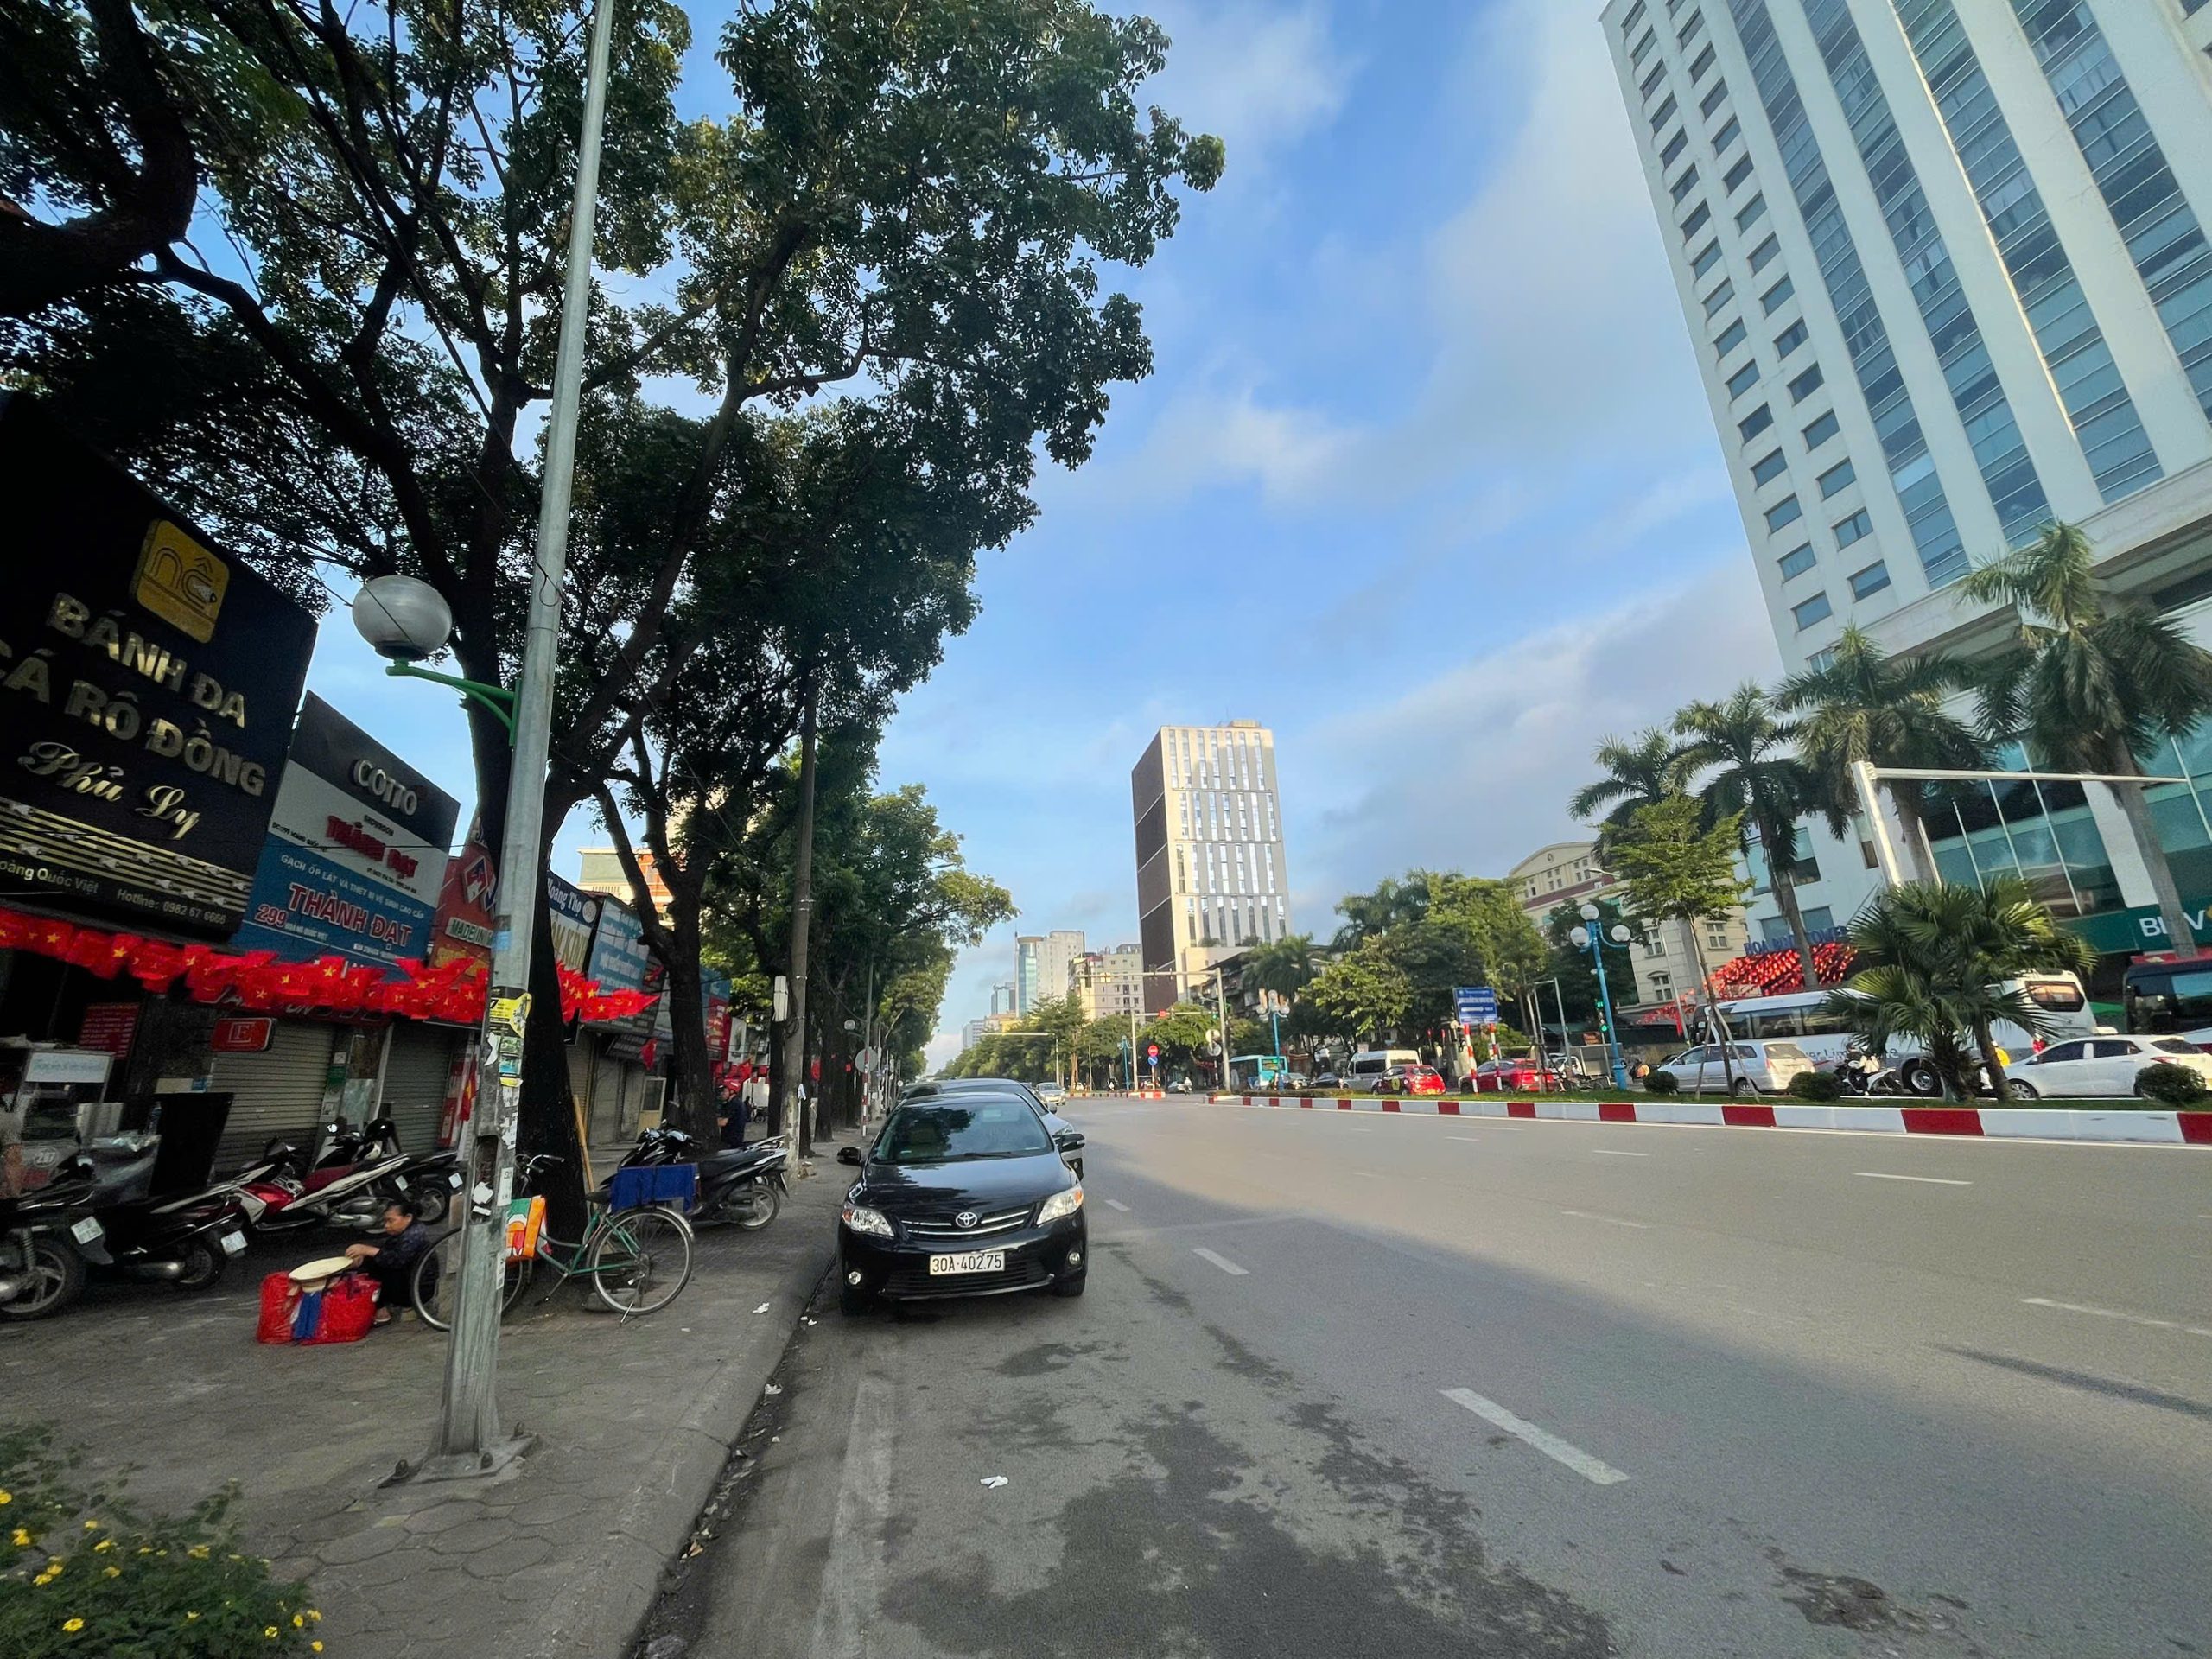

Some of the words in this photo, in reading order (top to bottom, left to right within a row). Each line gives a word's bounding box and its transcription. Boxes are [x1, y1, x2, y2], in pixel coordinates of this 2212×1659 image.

[46, 592, 188, 692] BÁNH
[64, 679, 141, 741] RÔ
[144, 717, 267, 797] ĐỒNG
[353, 760, 418, 817] COTTO
[281, 854, 307, 871] GẠCH
[36, 868, 73, 887] Quốc
[74, 877, 100, 895] Việt
[253, 903, 289, 928] 299
[288, 881, 369, 934] THÀNH
[369, 913, 413, 951] ĐẠT
[451, 918, 476, 941] MADE
[2139, 909, 2206, 938] BIV
